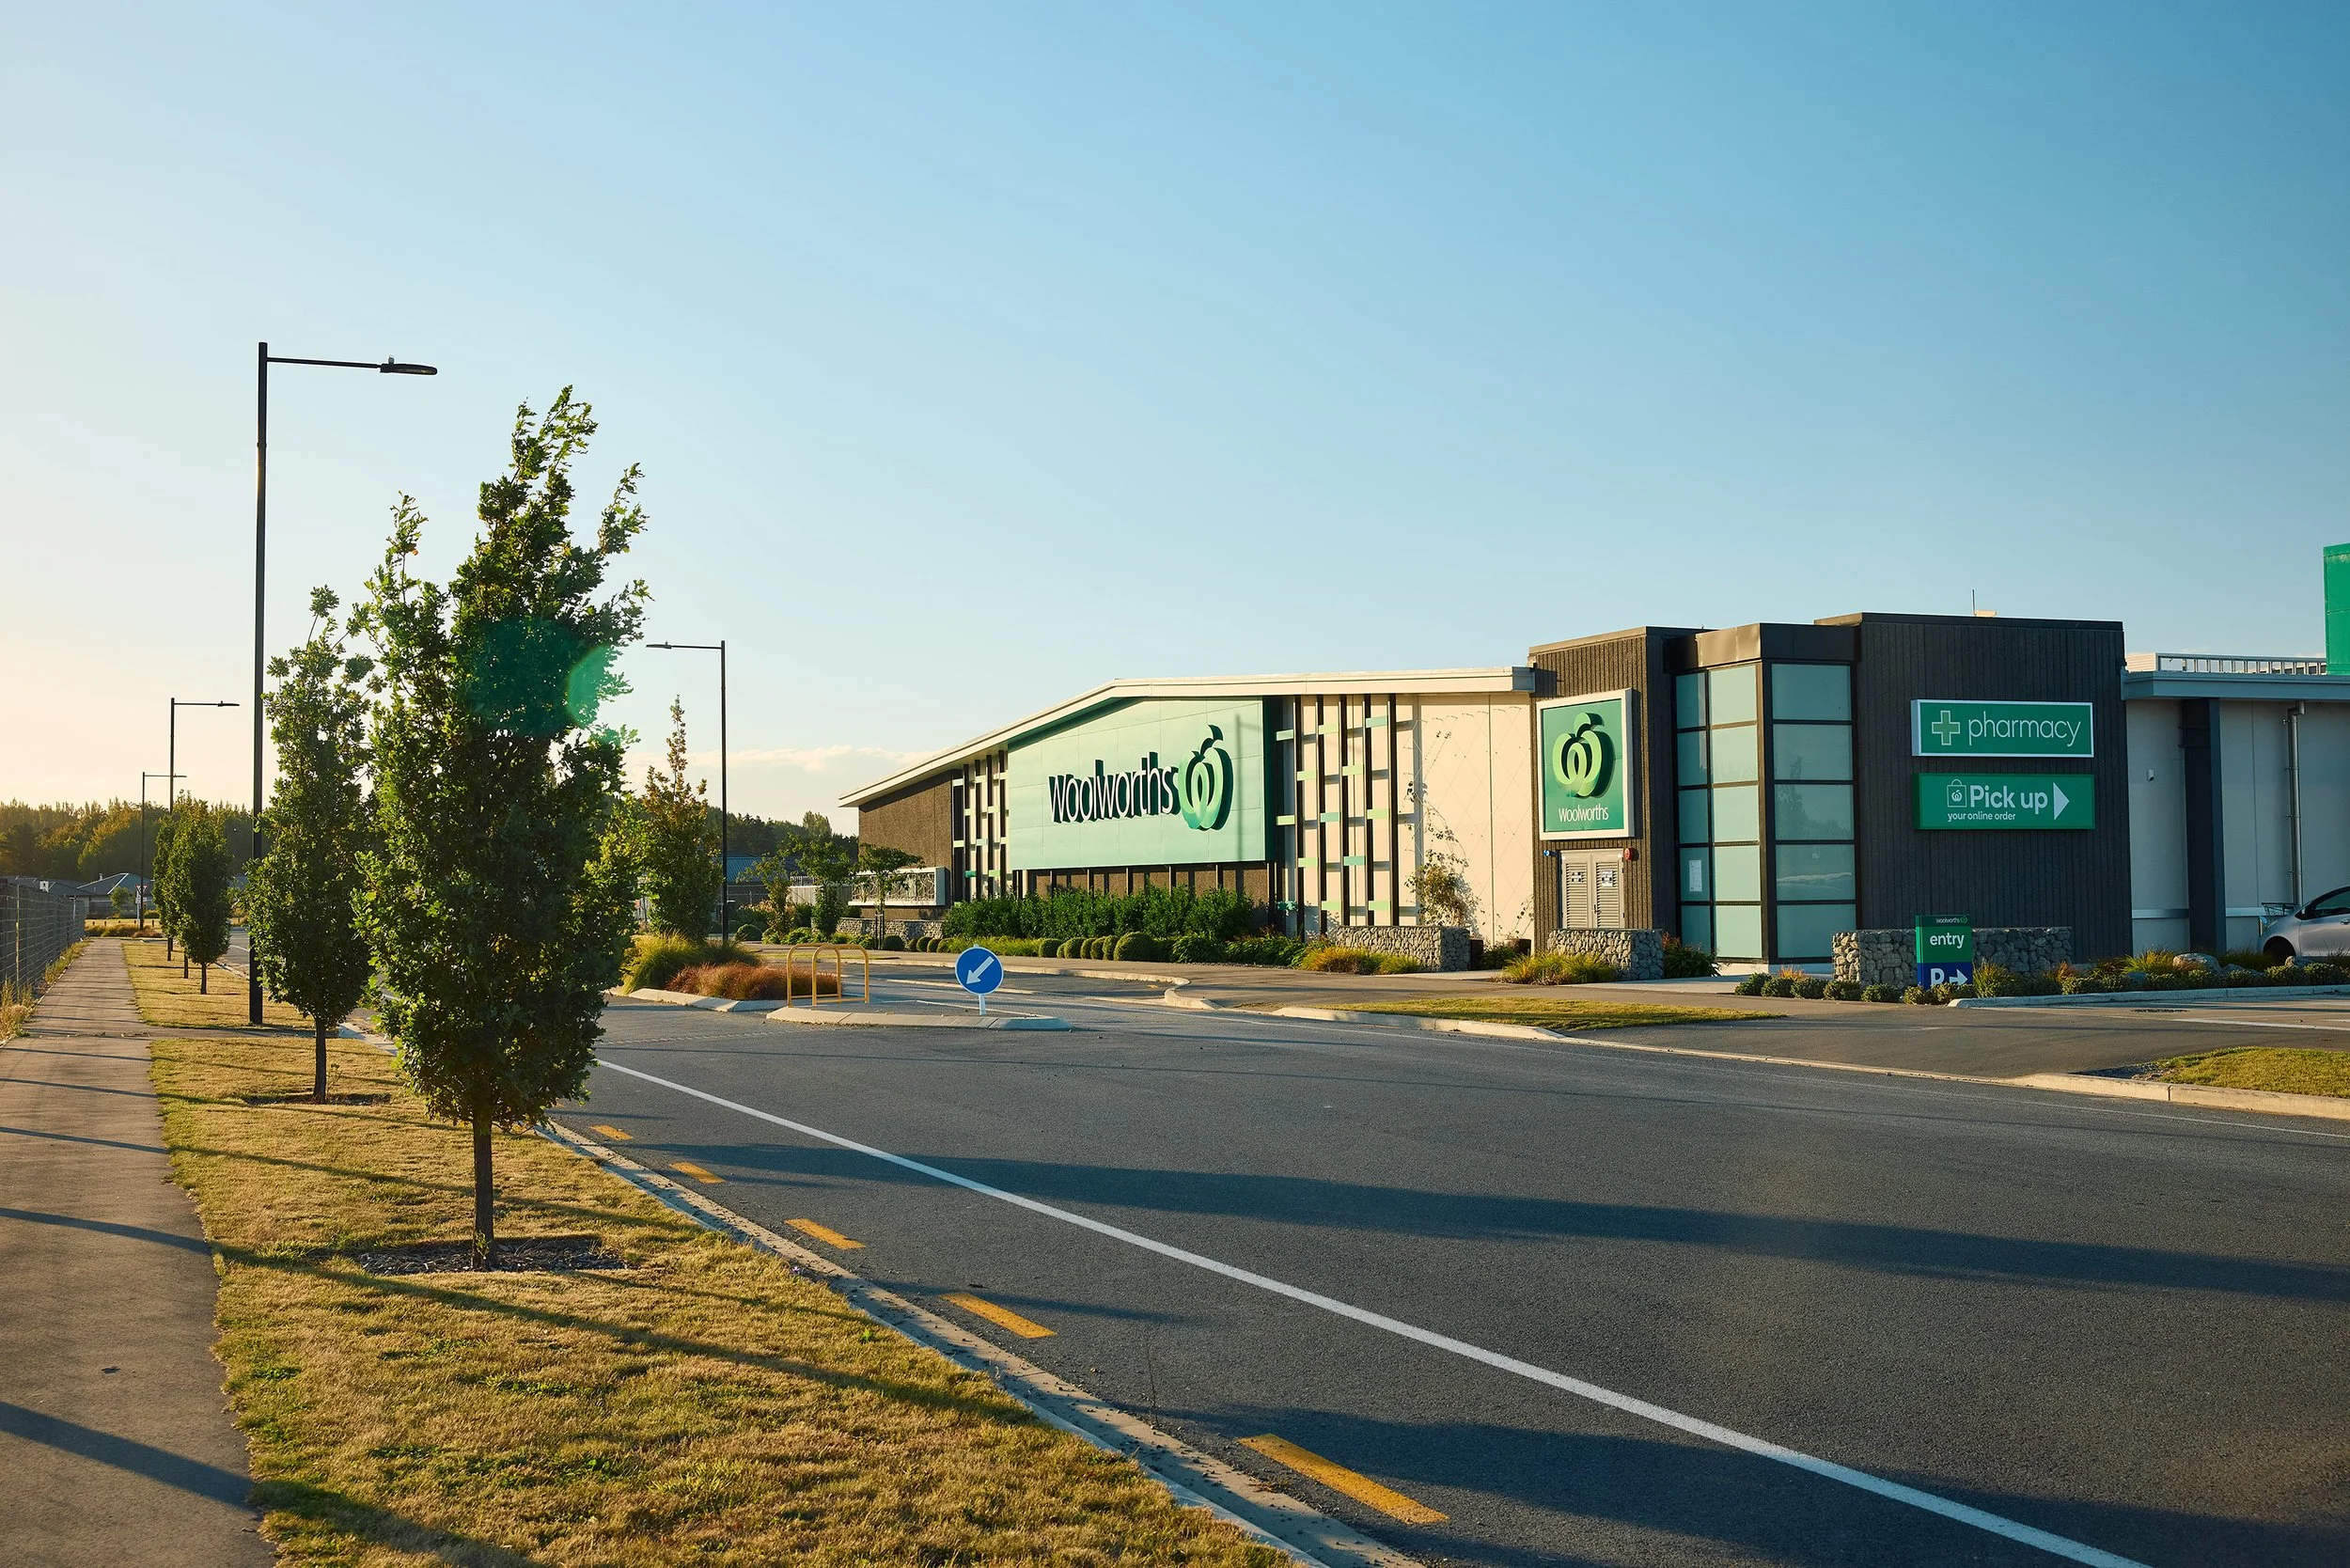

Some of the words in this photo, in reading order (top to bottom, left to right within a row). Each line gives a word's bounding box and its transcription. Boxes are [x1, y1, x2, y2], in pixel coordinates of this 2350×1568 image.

[1968, 711, 2081, 747] pharmacy
[1969, 785, 2016, 808] Pick
[2020, 792, 2048, 815] up
[1948, 812, 1966, 823] your
[1967, 810, 1993, 821] online
[1994, 811, 2016, 821] order
[1929, 932, 1965, 949] entry
